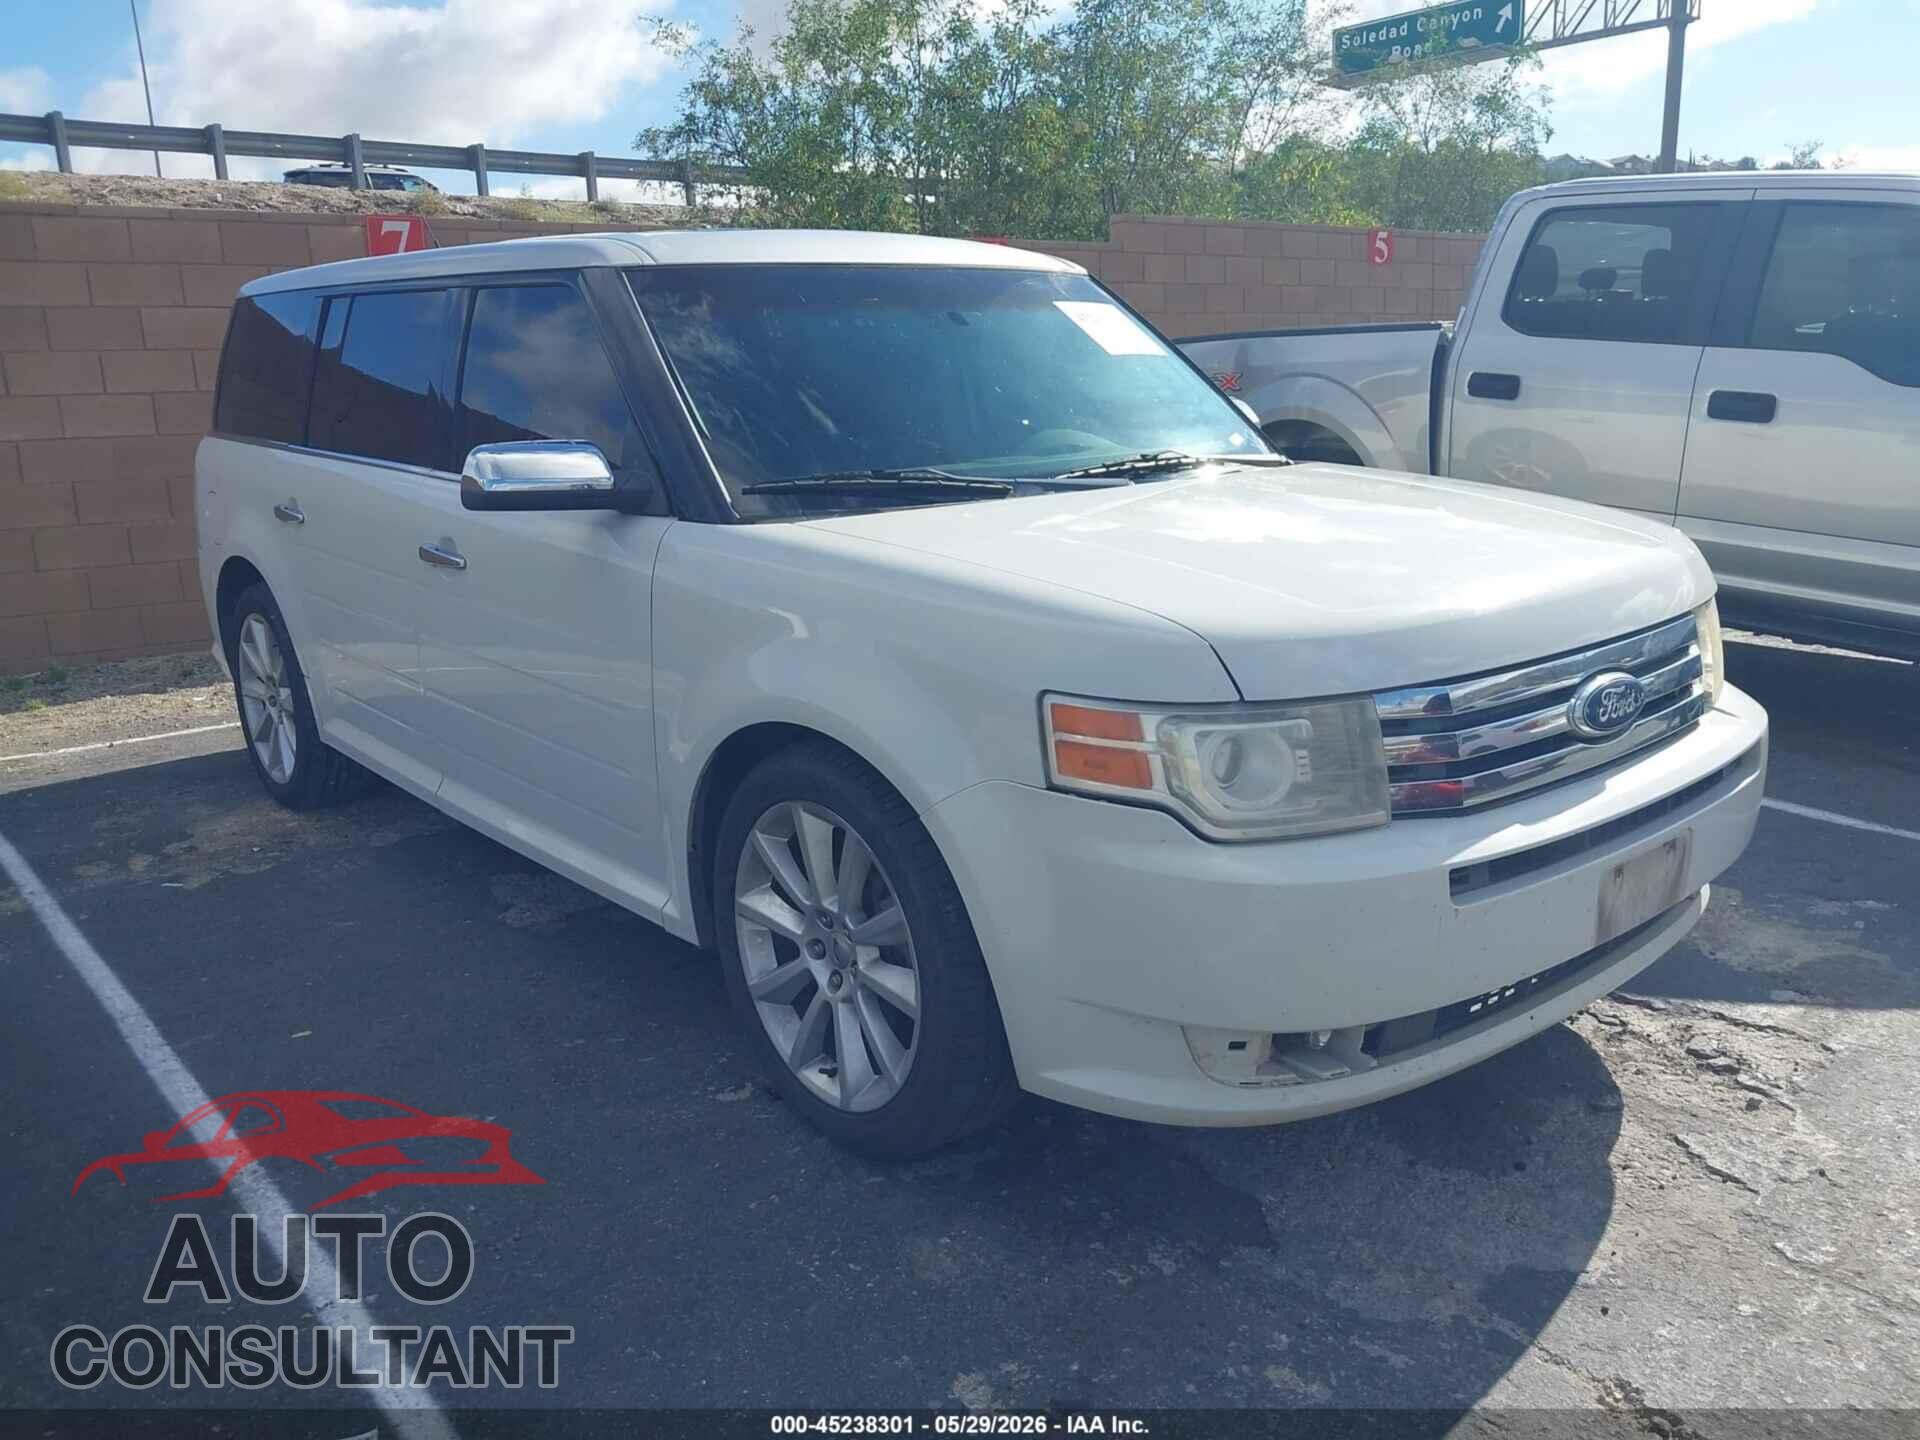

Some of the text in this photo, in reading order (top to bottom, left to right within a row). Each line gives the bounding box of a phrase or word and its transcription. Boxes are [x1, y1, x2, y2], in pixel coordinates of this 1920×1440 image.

[1341, 7, 1483, 49] Soledad Canyon
[381, 220, 410, 254] 7
[1374, 231, 1389, 263] 5
[1600, 685, 1643, 722] Ford
